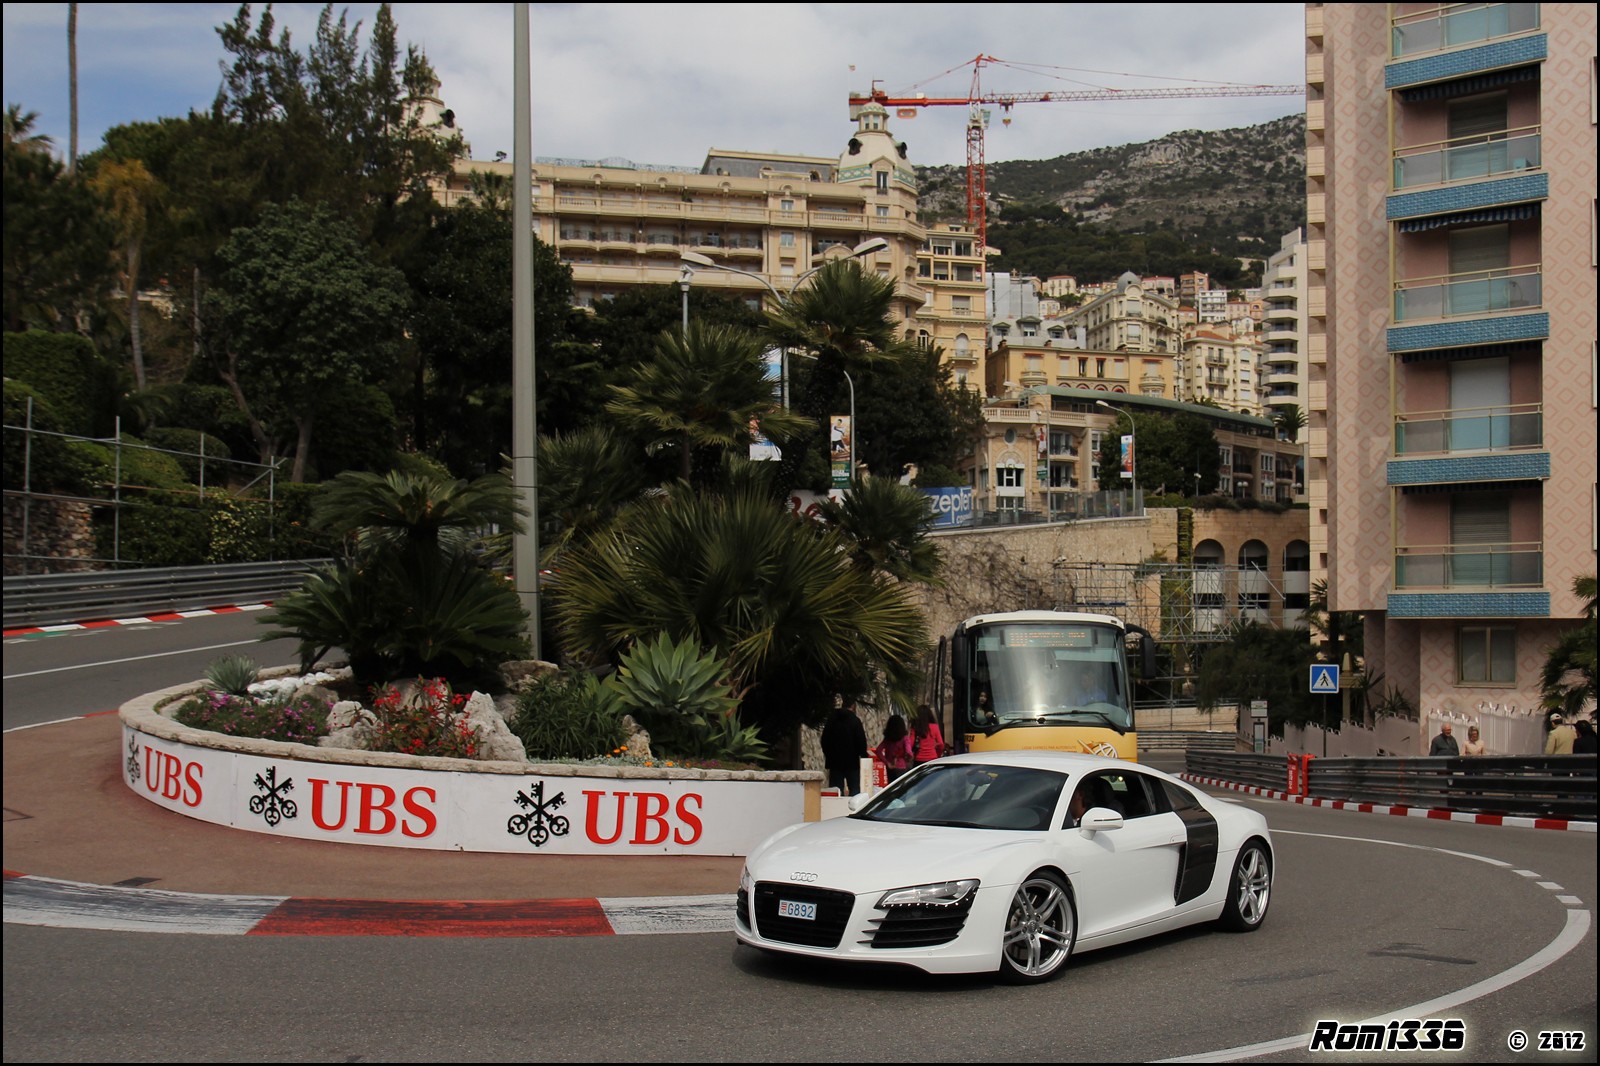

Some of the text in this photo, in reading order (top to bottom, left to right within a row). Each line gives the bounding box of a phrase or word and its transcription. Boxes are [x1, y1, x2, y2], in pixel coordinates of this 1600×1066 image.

[145, 746, 204, 808] UBS
[307, 778, 437, 839] UBS
[581, 789, 703, 846] UBS
[787, 902, 814, 918] G892
